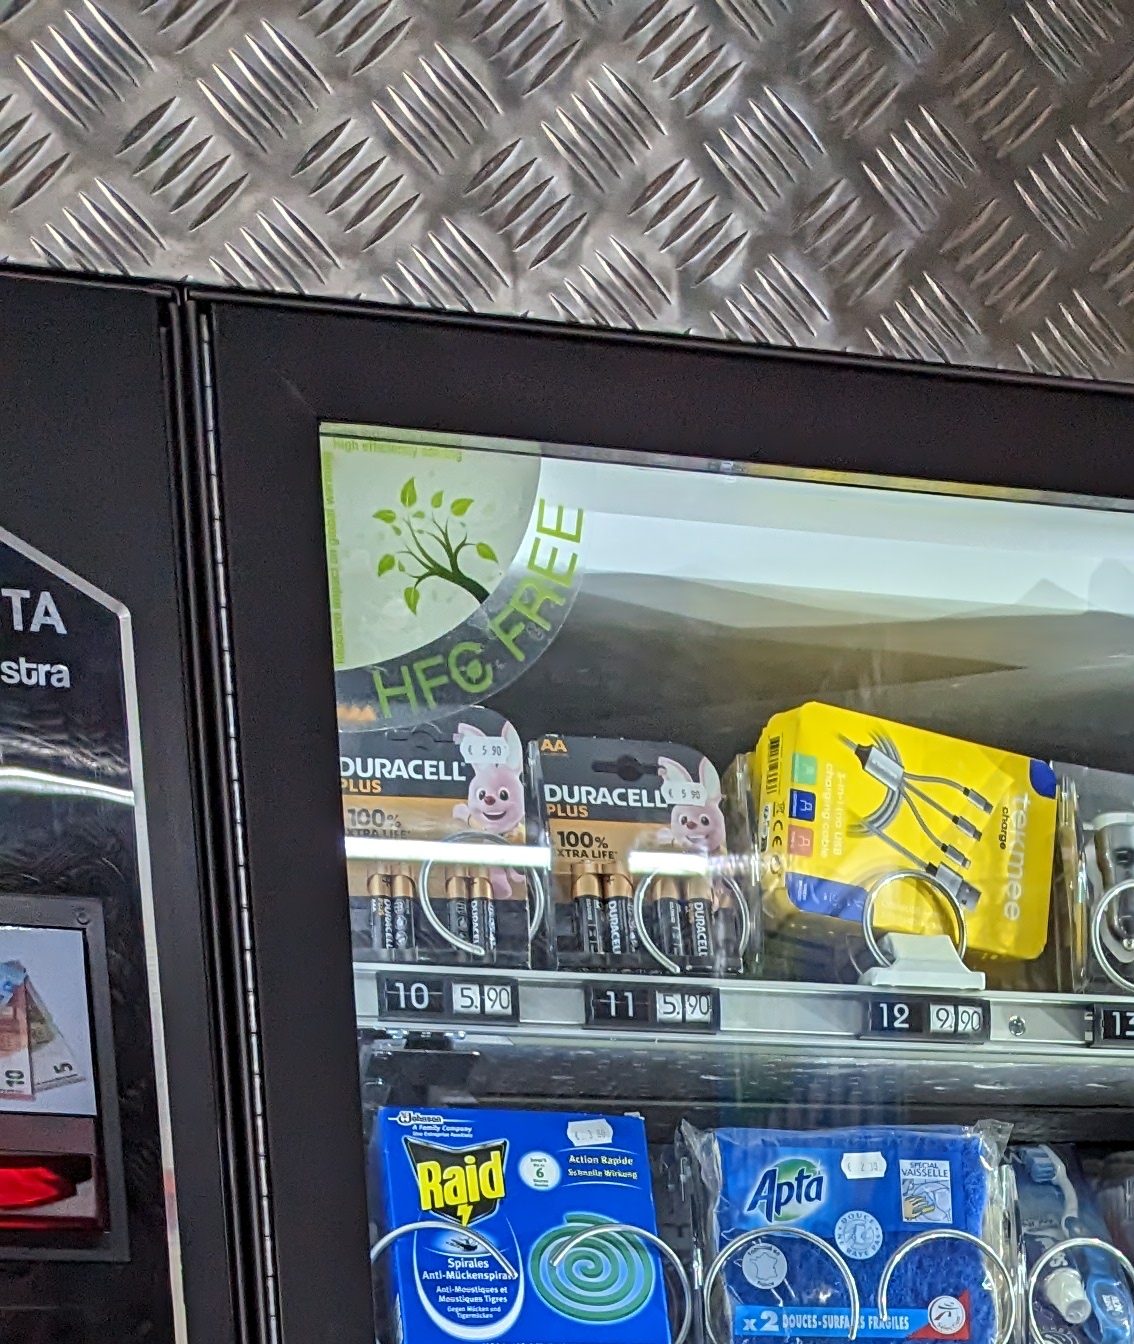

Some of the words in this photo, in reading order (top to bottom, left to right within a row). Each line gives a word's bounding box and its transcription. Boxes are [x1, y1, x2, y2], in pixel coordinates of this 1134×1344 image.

[487, 498, 584, 662] FREE
[541, 739, 567, 752] AA
[338, 757, 466, 781] DURACELL
[544, 783, 668, 808] DURACELL
[347, 808, 402, 828] 100%
[546, 803, 589, 818] PLUS
[998, 806, 1010, 850] charge
[557, 830, 609, 849] 100%
[1003, 793, 1029, 921] tekmee
[395, 982, 428, 1009] 10
[569, 1154, 599, 1165] Action
[601, 1156, 634, 1168] Rapide
[416, 1151, 506, 1211] Raid
[535, 1167, 545, 1179] 6
[901, 1168, 949, 1179] VAISSELLE
[746, 1168, 824, 1223] Apta
[447, 1258, 490, 1271] Spirales
[868, 1314, 910, 1330] FRAGILES
